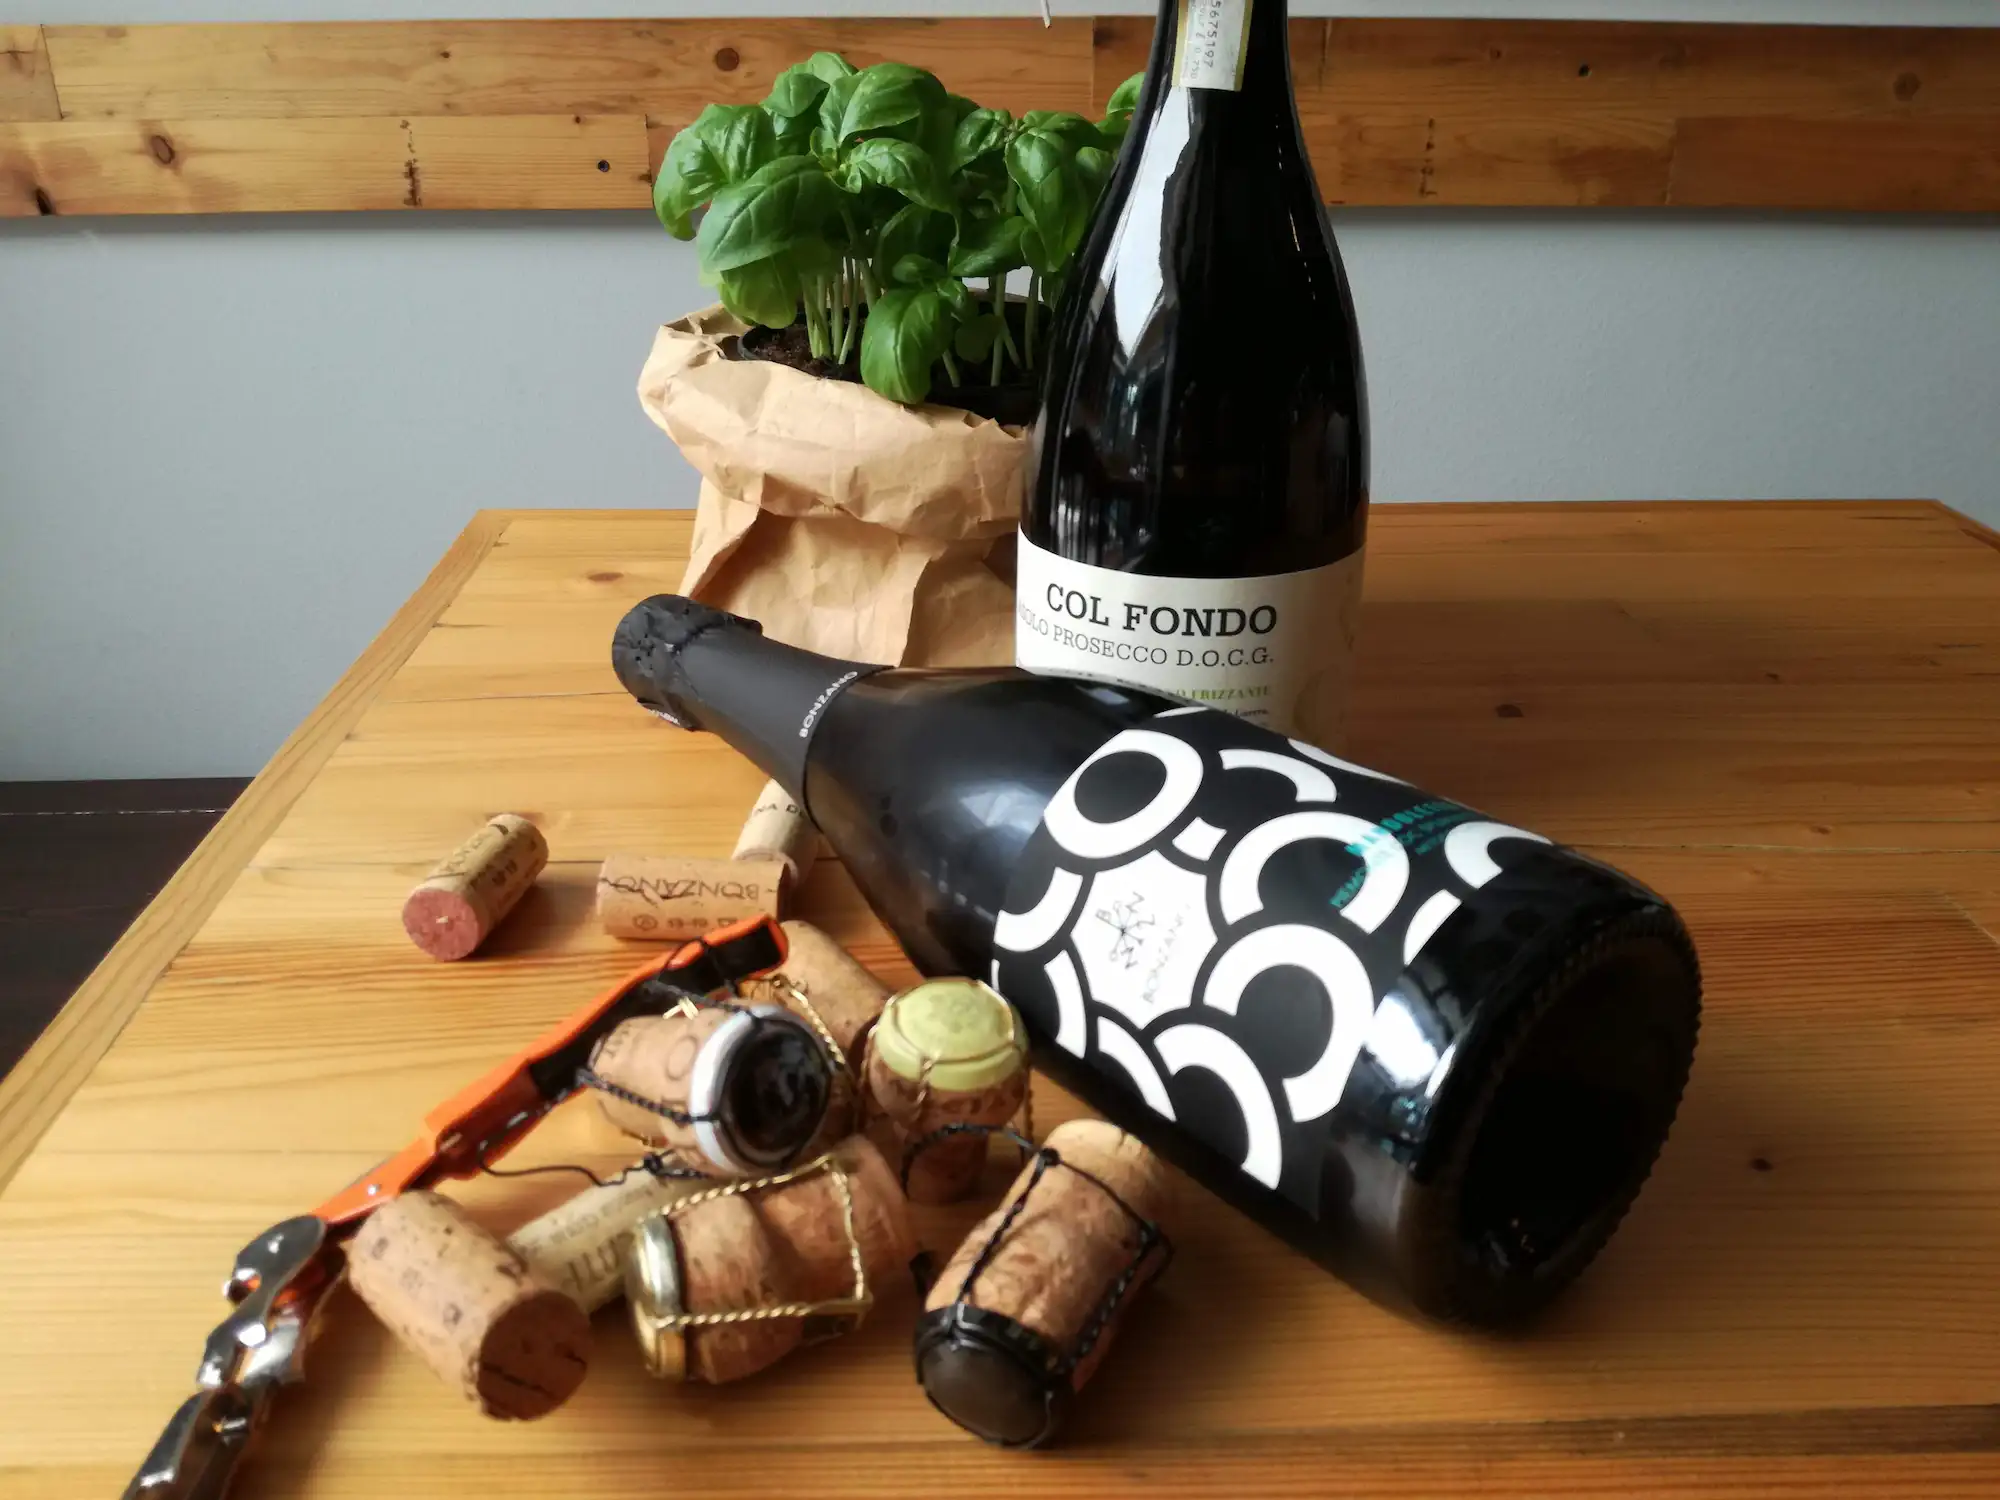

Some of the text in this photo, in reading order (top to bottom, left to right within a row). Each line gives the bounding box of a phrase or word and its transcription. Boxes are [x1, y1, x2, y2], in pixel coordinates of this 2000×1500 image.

[1046, 583, 1278, 638] COL FONDO
[1052, 626, 1169, 666] PROSECCO
[1176, 647, 1275, 668] D.O.C.G.
[799, 671, 858, 738] BONZANO
[613, 875, 760, 901] BONZANO
